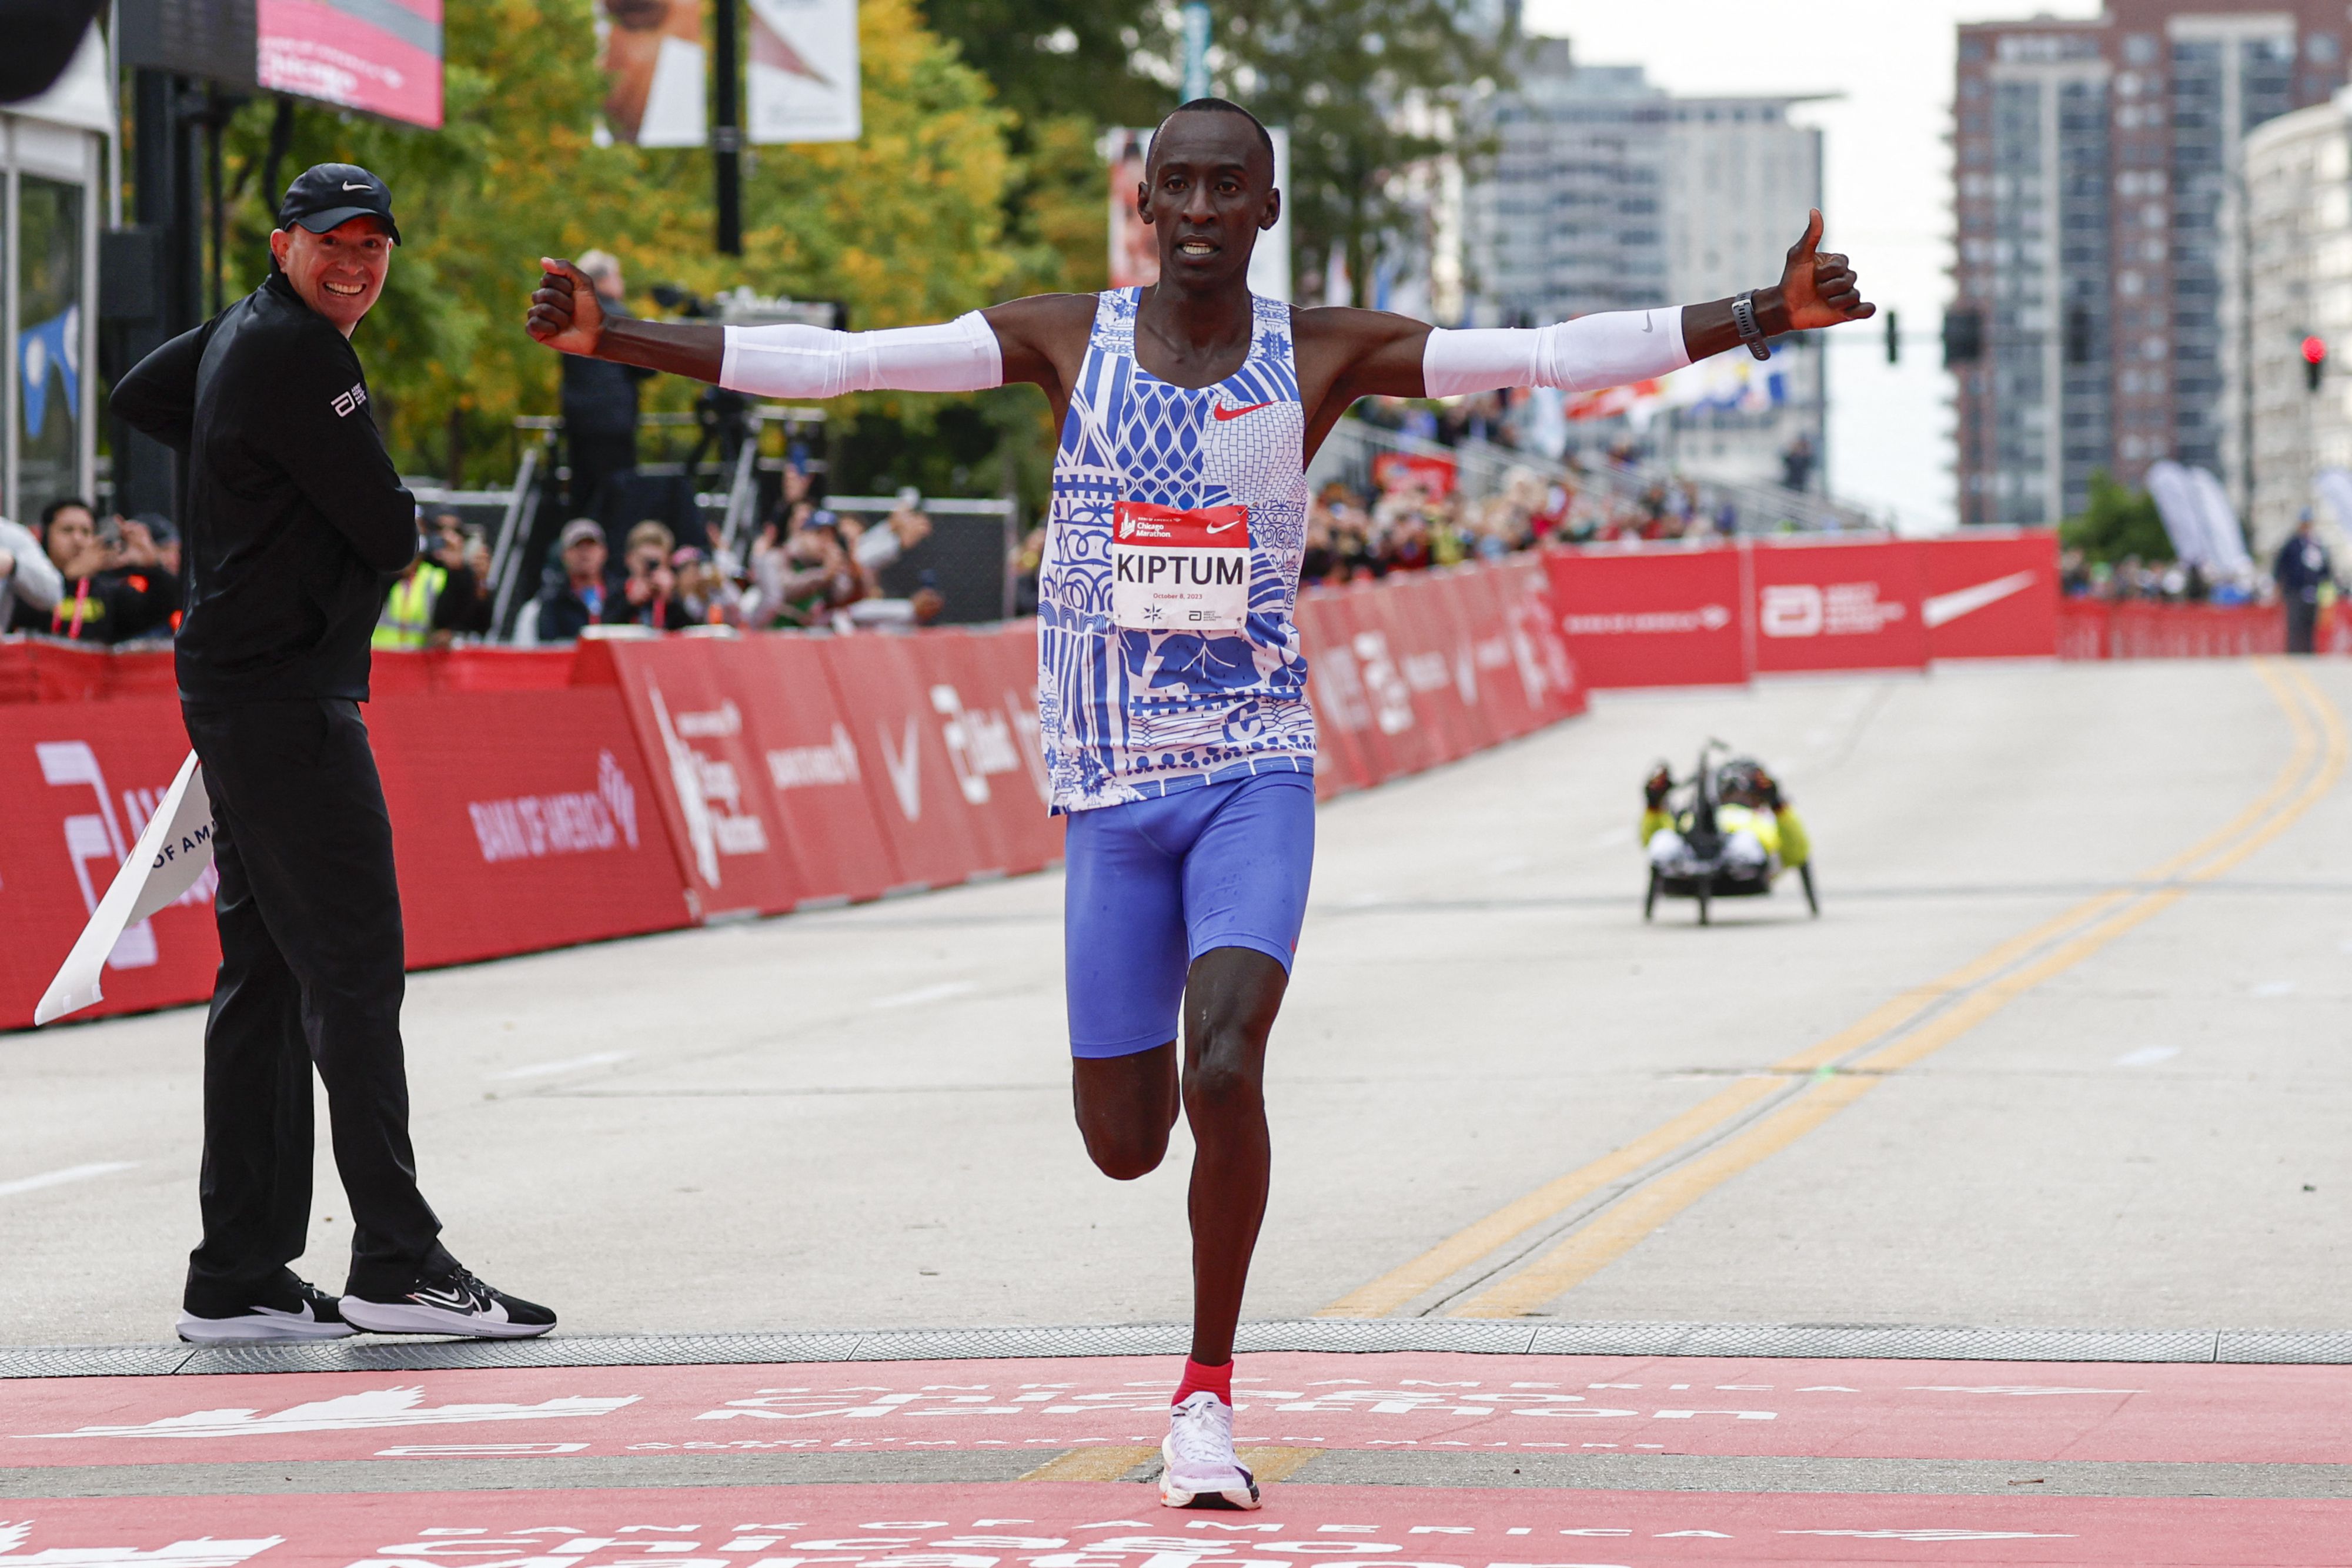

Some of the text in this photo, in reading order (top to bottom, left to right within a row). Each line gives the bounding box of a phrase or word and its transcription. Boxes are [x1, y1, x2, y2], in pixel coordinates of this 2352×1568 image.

[1137, 522, 1164, 531] Chicago
[1118, 553, 1242, 585] KIPTUM
[754, 1383, 1080, 1394] BANK
[1306, 1379, 1862, 1393] AMERICA
[905, 1436, 1324, 1445] MARATON
[1366, 1439, 1665, 1449] MAJORS
[418, 1519, 1735, 1538] BANK OF AMERICA
[376, 1535, 1404, 1555] Chicago
